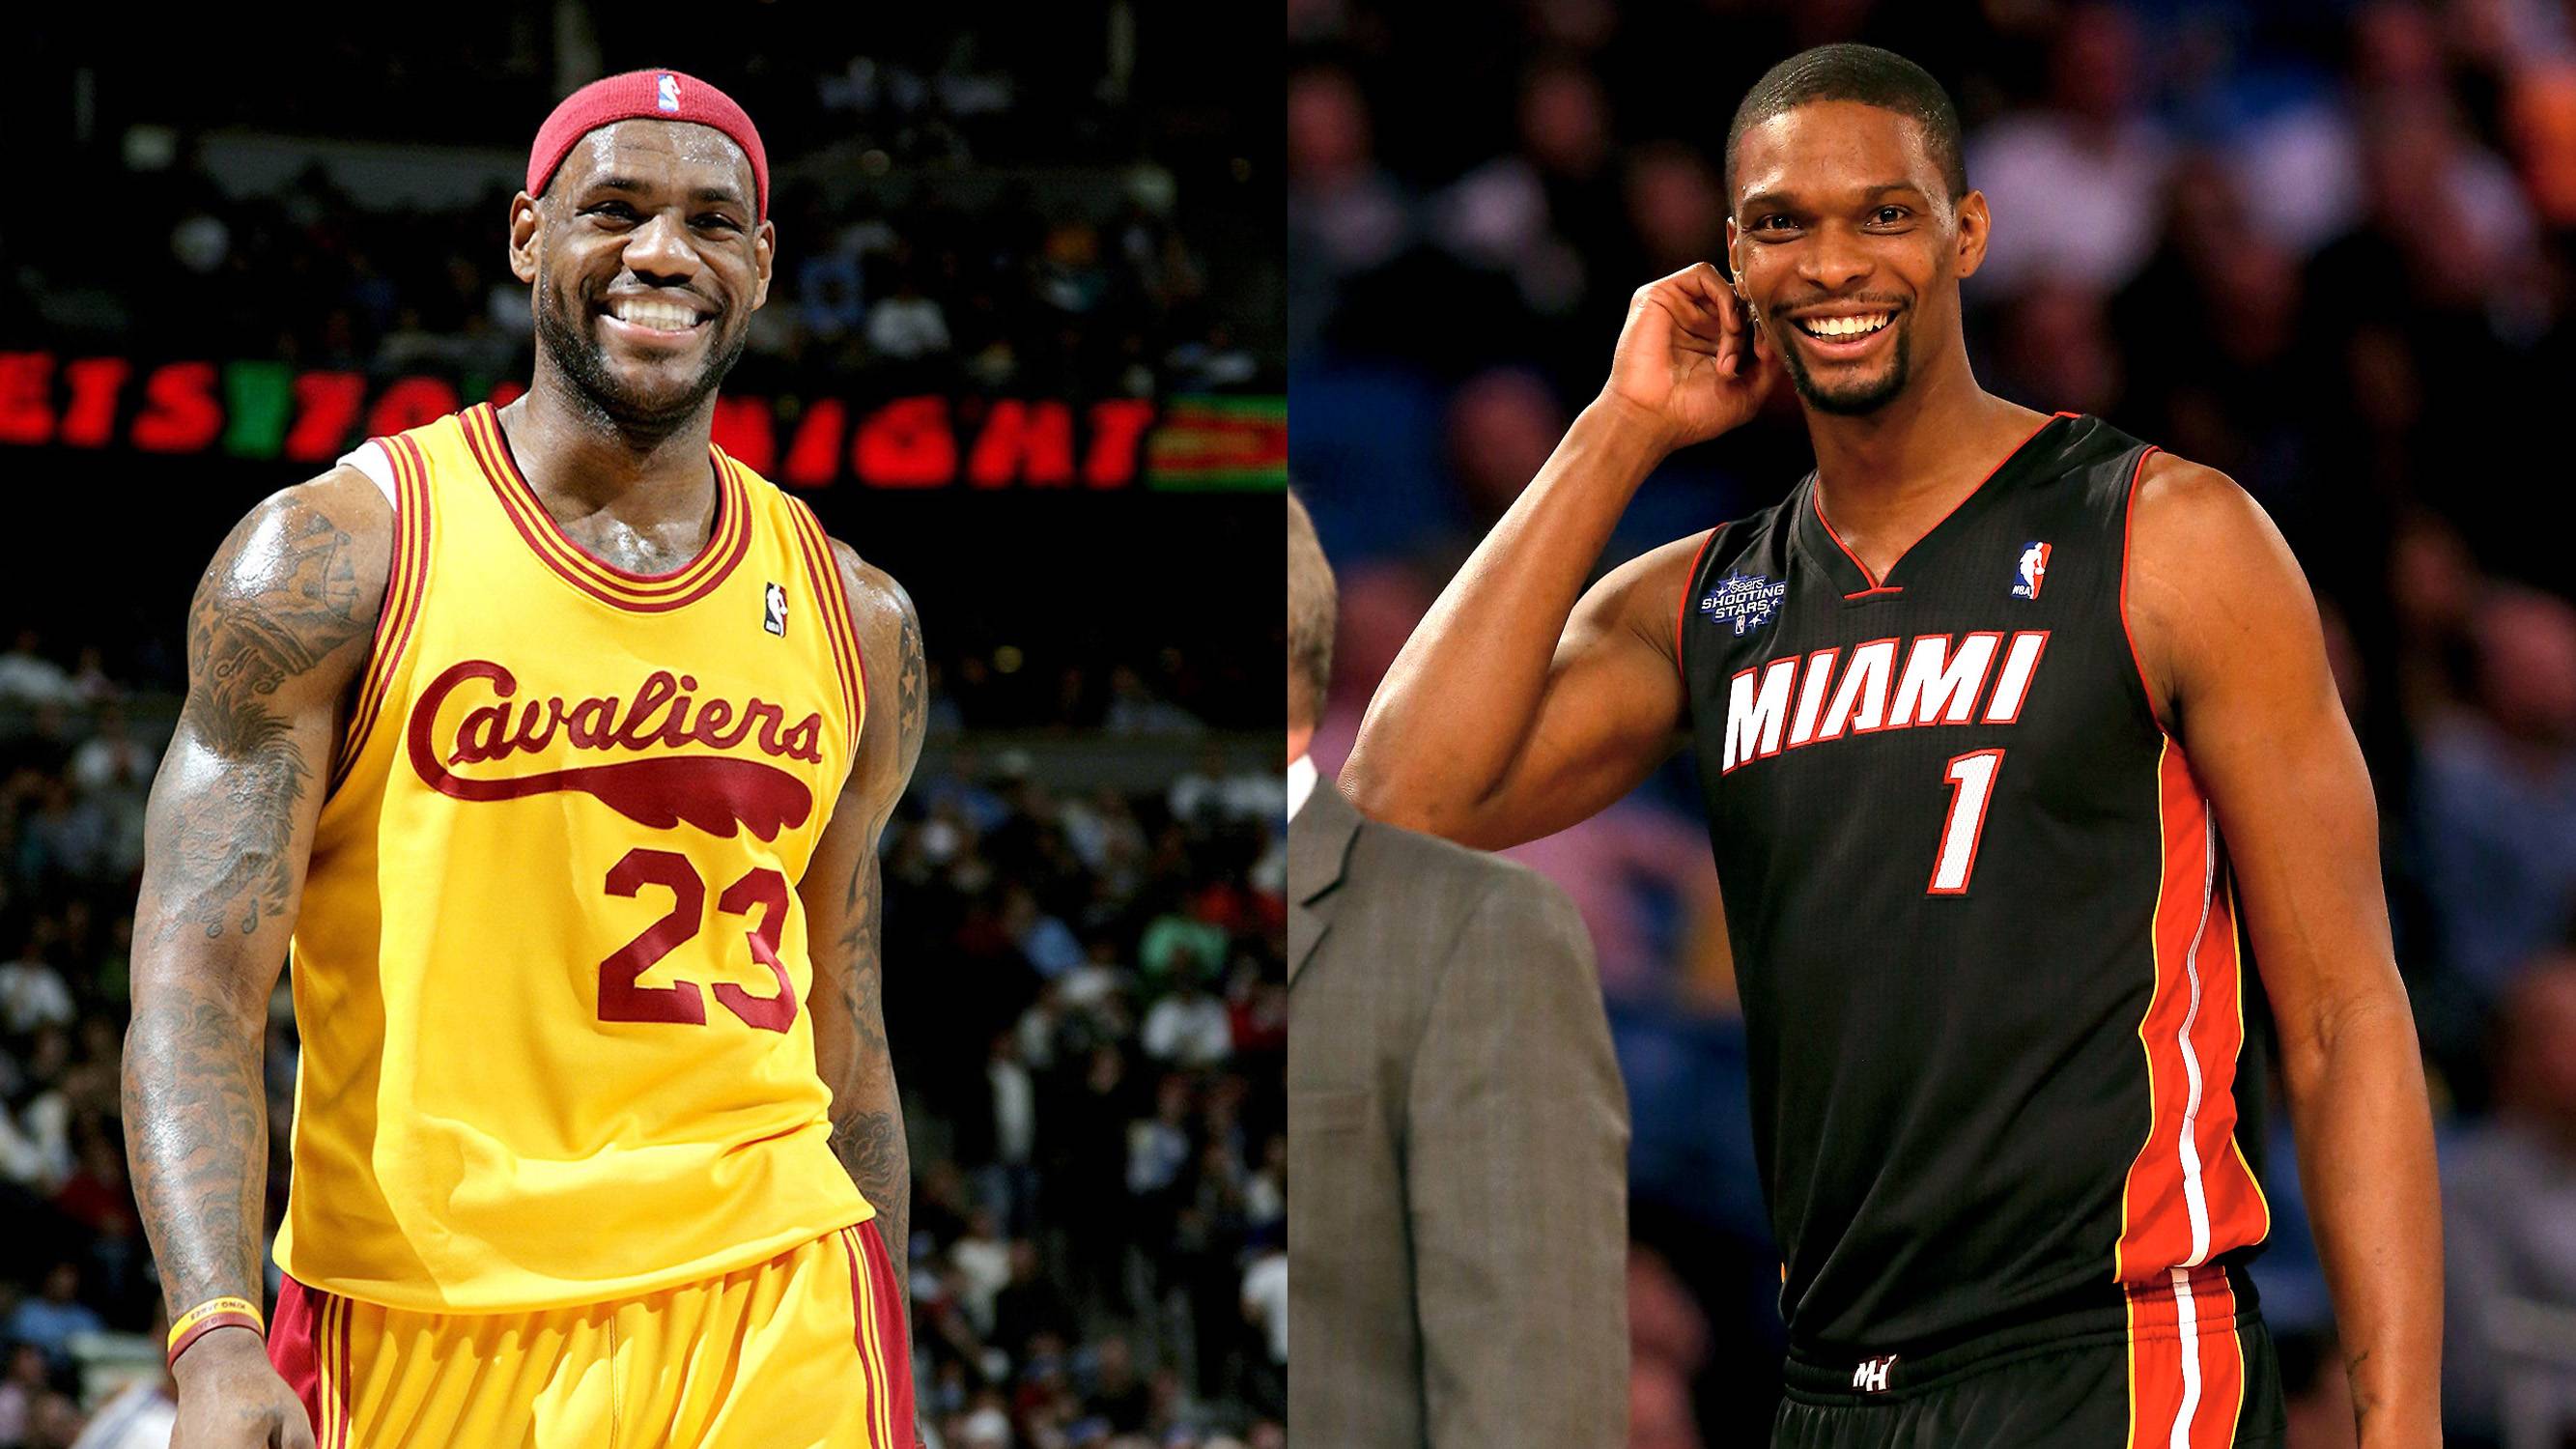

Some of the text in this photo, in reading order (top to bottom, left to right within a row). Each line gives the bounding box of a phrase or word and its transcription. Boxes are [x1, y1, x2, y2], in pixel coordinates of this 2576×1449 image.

[1701, 584, 1785, 610] SHOOTING
[1714, 599, 1769, 619] STARS
[1730, 578, 1766, 593] sears
[2012, 584, 2031, 596] NBA
[407, 659, 824, 803] Cavaliers
[1722, 630, 2052, 776] MIAMI
[1926, 748, 2006, 895] 1
[597, 847, 799, 1035] 23
